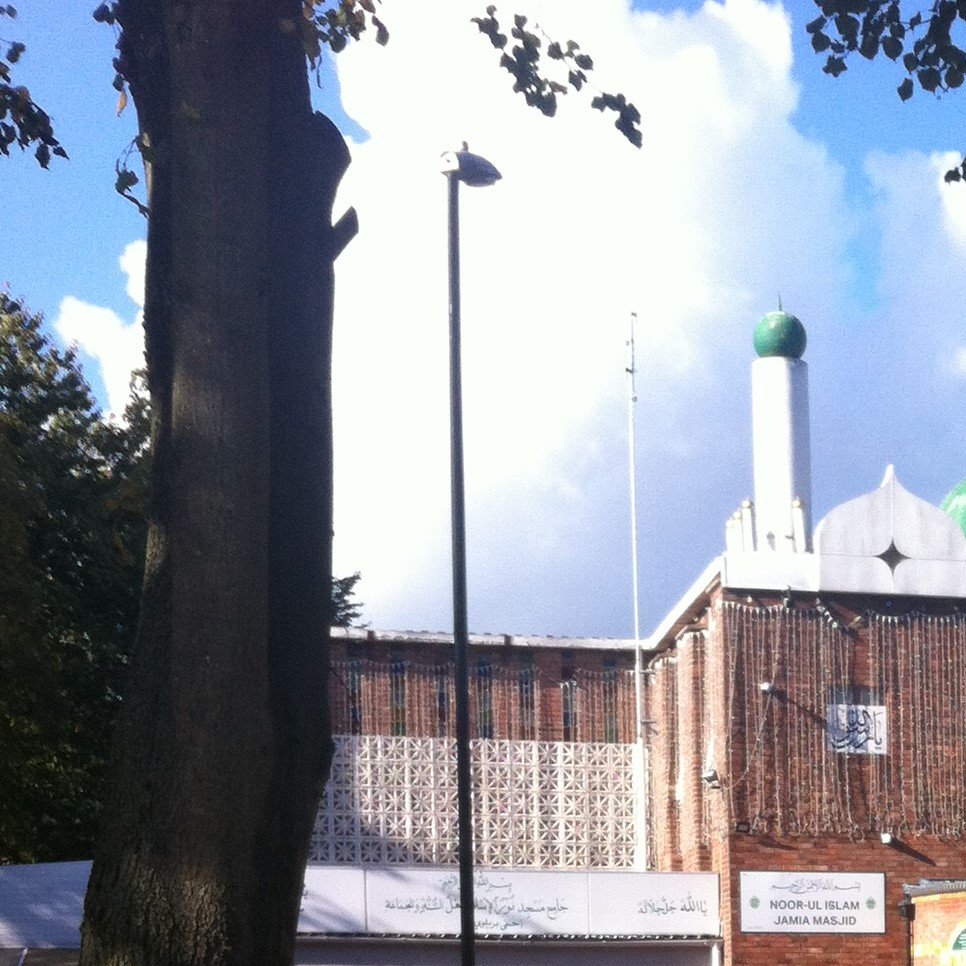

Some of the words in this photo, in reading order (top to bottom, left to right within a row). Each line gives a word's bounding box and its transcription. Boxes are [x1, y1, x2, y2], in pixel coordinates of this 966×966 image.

[769, 899, 823, 910] NOOR-UL
[824, 901, 860, 911] ISLAM
[773, 916, 810, 926] JAMIA
[812, 915, 857, 926] MASJID
